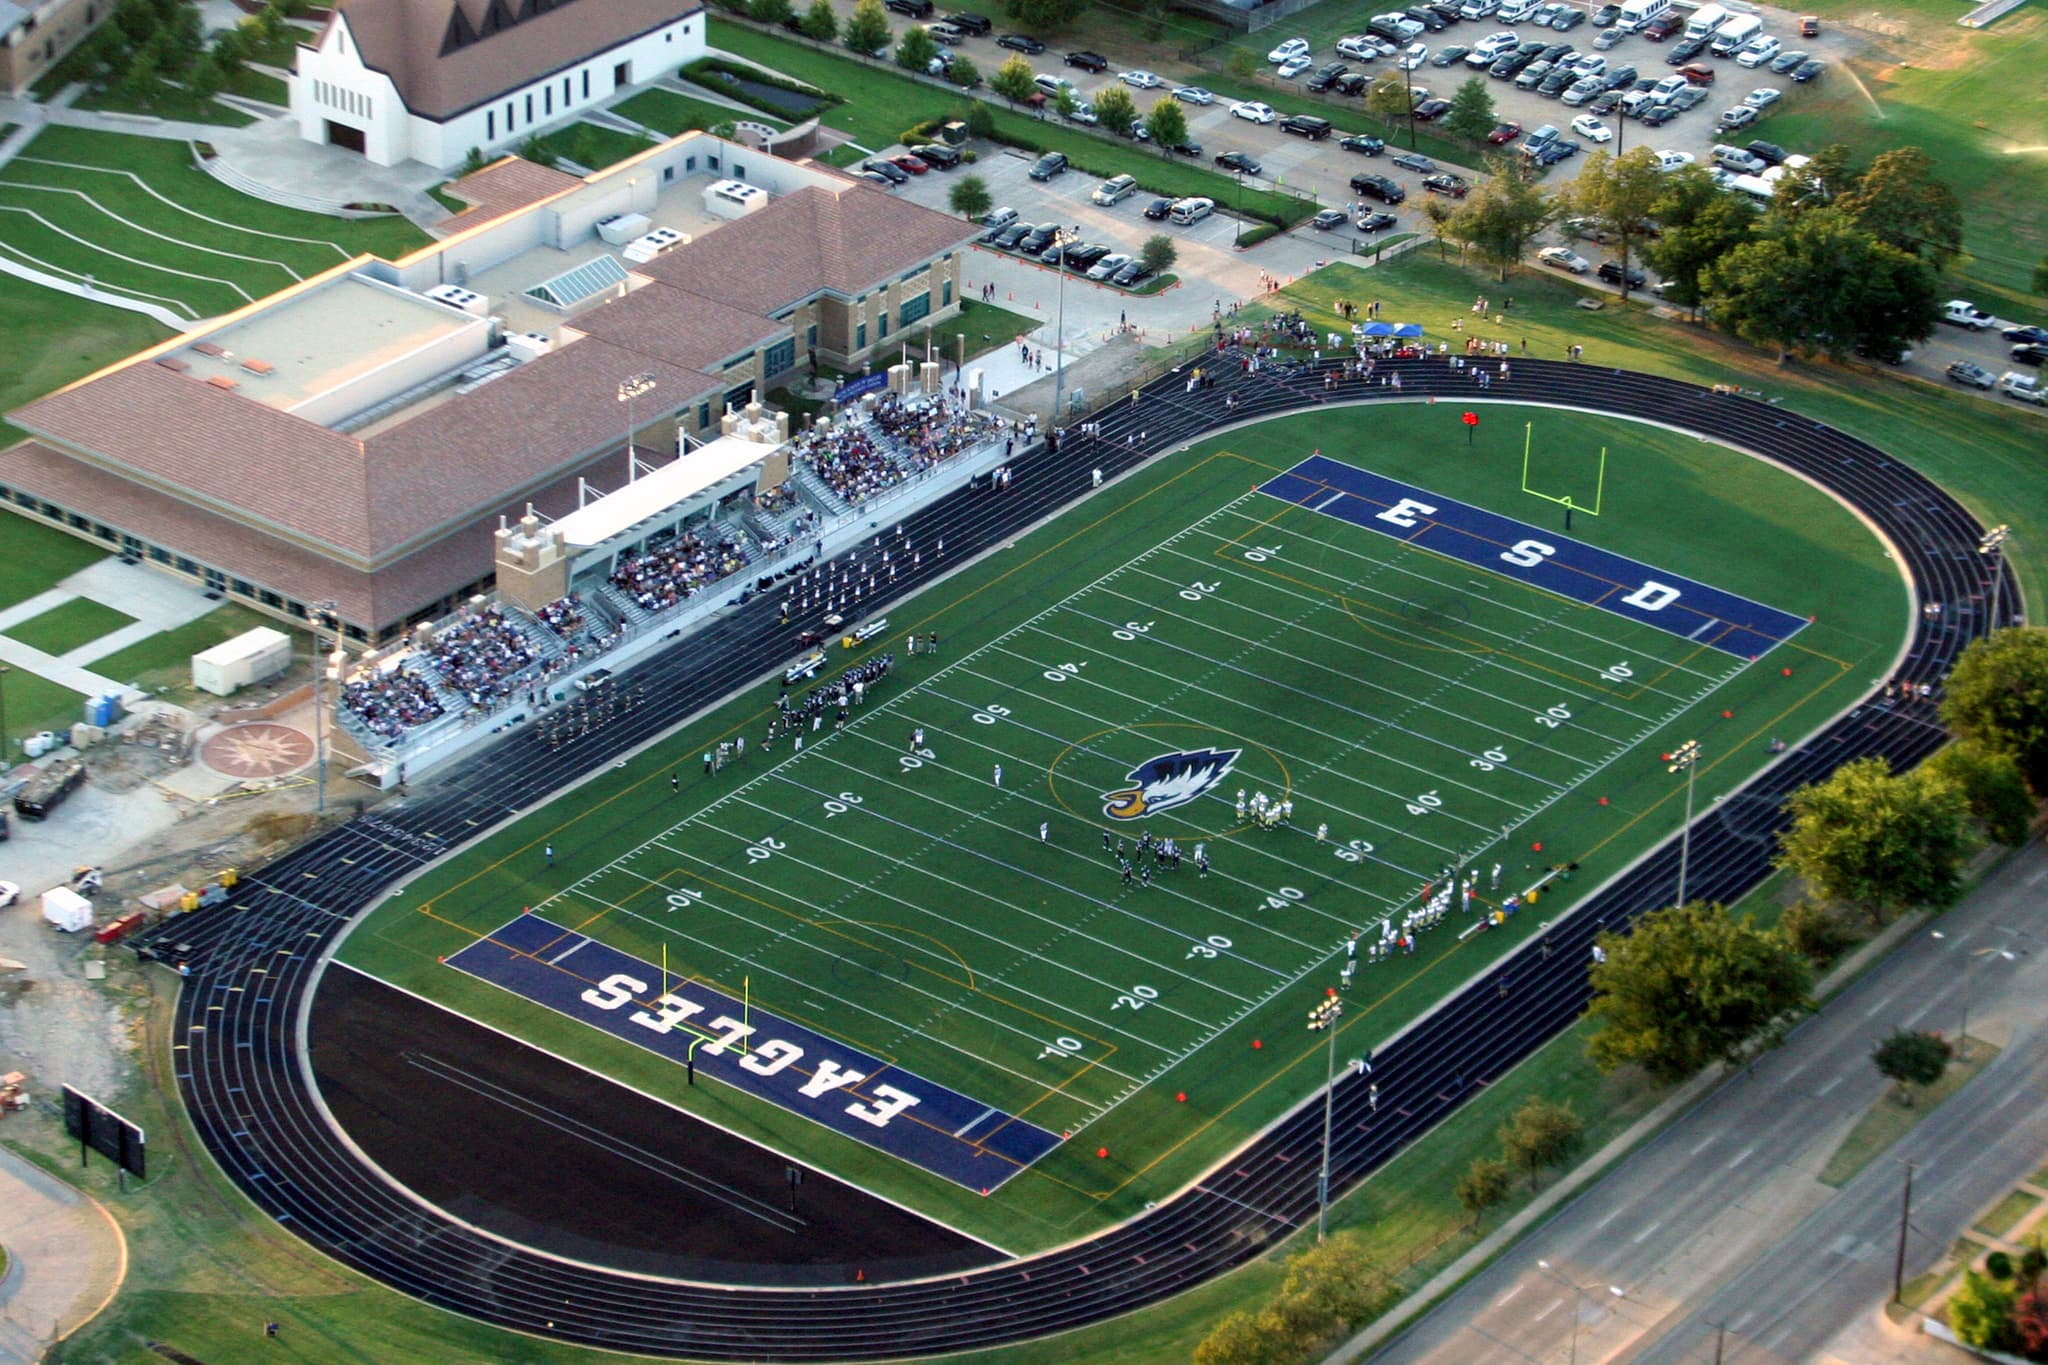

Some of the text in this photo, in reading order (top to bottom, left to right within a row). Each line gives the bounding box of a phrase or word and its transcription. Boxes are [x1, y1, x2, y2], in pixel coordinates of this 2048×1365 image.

[1244, 546, 1277, 562] 10
[1178, 581, 1215, 601] 20
[1112, 621, 1149, 641] 30
[1043, 663, 1079, 682] 40
[1601, 665, 1633, 682] 10
[972, 704, 1011, 725] 50
[1534, 707, 1571, 728] 20
[1469, 750, 1507, 771] 30
[823, 791, 863, 813] 30
[1406, 794, 1442, 815] 40
[746, 836, 786, 859] 20
[1334, 840, 1374, 861] 50
[666, 888, 702, 907] 10
[1266, 887, 1304, 909] 40
[1191, 935, 1232, 959] 30
[1117, 985, 1158, 1010] 20
[580, 974, 921, 1127] EAGLES
[1045, 1037, 1082, 1058] 10
